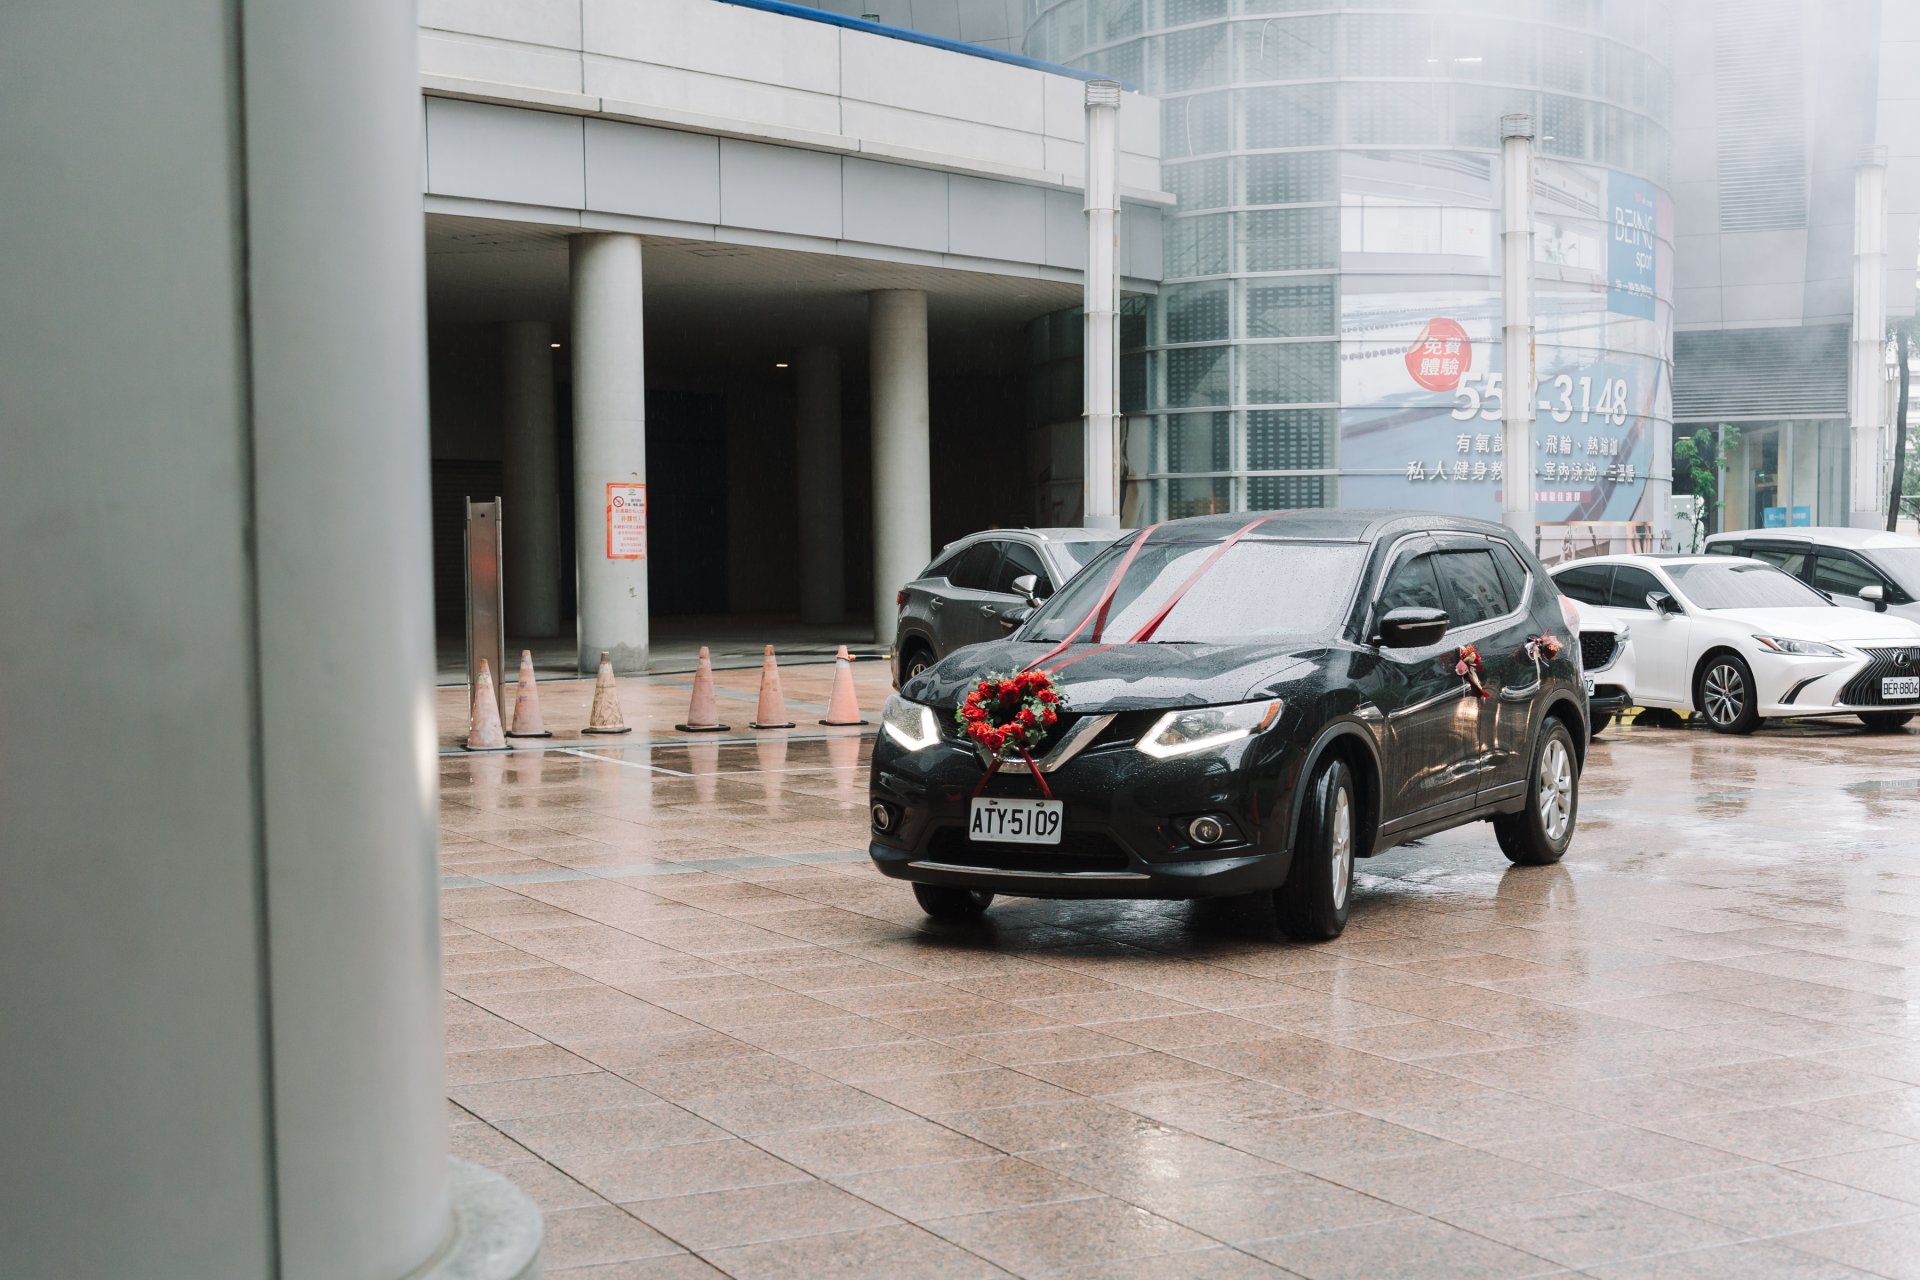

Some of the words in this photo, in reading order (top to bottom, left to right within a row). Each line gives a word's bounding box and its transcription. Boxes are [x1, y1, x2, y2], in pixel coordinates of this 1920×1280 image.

[1615, 206, 1653, 250] BEING
[1423, 337, 1460, 355] 免費
[1420, 358, 1459, 376] 體驗
[1451, 371, 1627, 426] 55-3148
